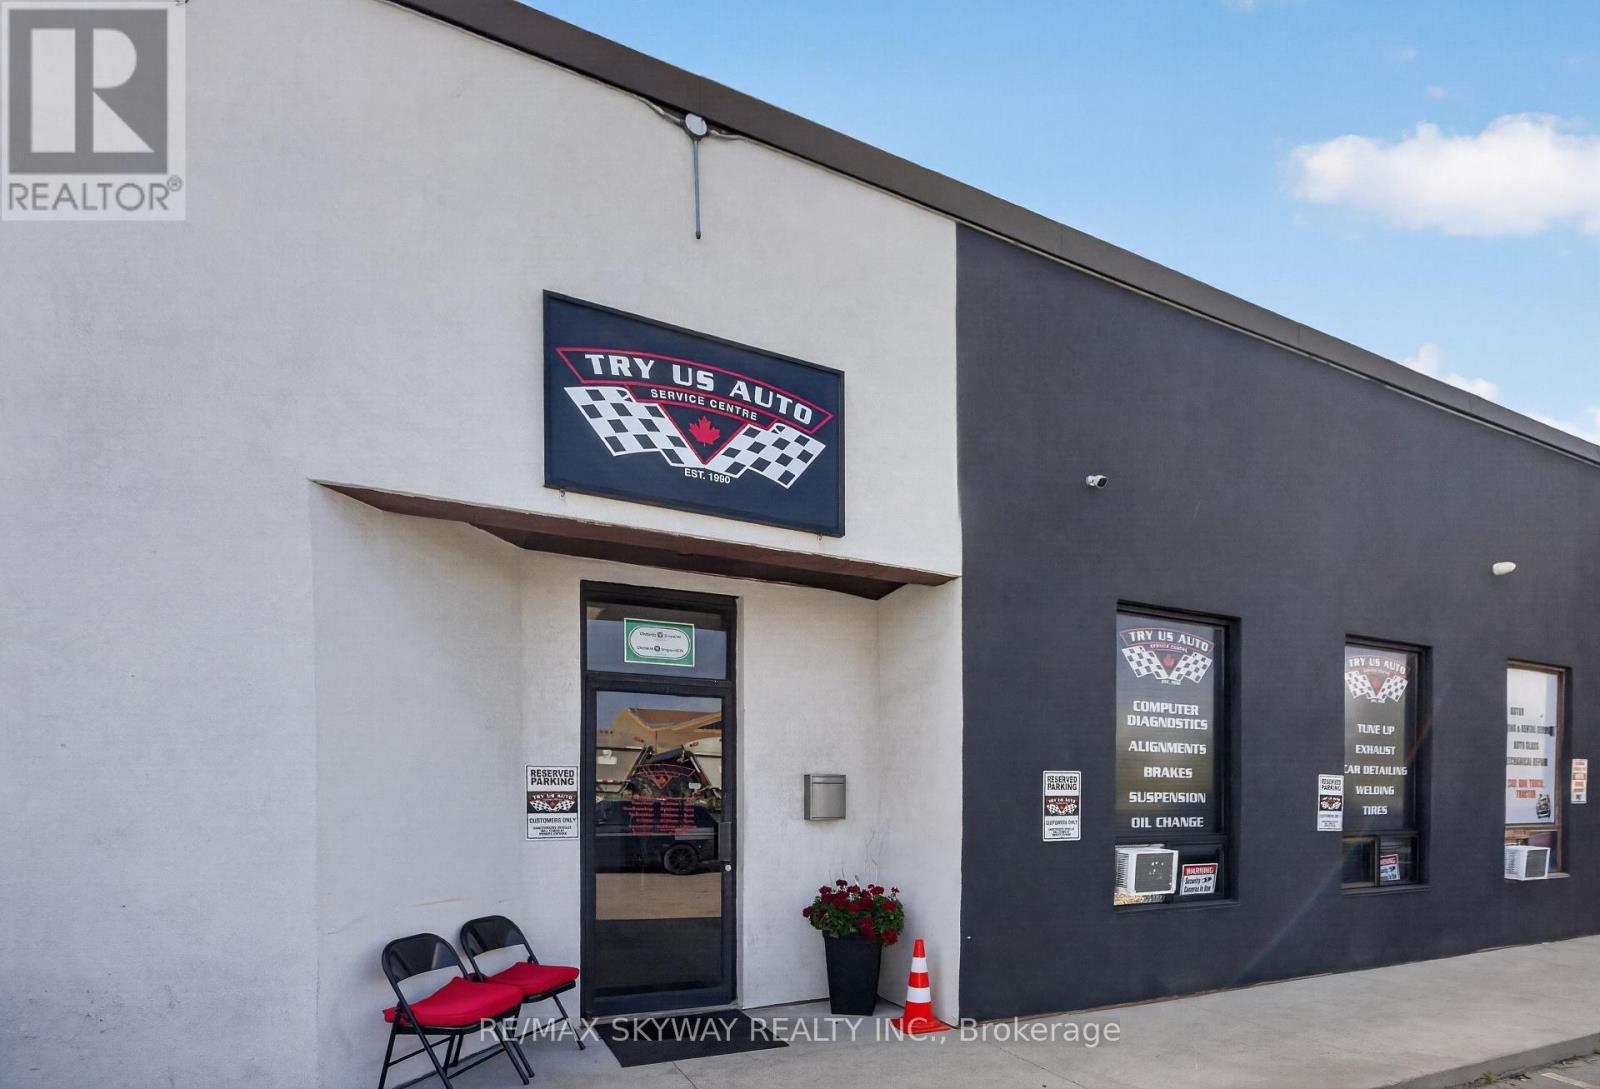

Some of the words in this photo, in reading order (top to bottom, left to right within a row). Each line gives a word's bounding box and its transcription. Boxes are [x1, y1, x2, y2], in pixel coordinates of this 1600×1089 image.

[585, 354, 654, 379] TRY
[672, 363, 714, 392] US
[729, 380, 813, 425] AUTO
[650, 388, 705, 406] SERVICE
[710, 400, 757, 421] CENTRE
[684, 468, 705, 480] EST.
[708, 472, 731, 484] 1990
[1128, 630, 1153, 642] TRY
[1158, 631, 1174, 642] US
[1178, 635, 1209, 652] AUTO
[1349, 657, 1366, 668] TRY
[1369, 657, 1380, 667] US
[1383, 660, 1406, 675] AUTO
[1133, 700, 1199, 716] COMPUTER
[1127, 714, 1208, 730] DIAGNOSTICS
[1357, 724, 1380, 734] TUNE
[1382, 725, 1395, 735] UP
[1128, 740, 1207, 755] ALIGNMENTS
[1355, 744, 1396, 755] EXHAUST
[530, 769, 575, 778] RESERVED
[1144, 767, 1193, 778] BRAKES
[1363, 765, 1408, 776] DETAILING
[530, 777, 575, 786] PARKING
[1047, 776, 1077, 784] RESERVED
[1047, 783, 1077, 791] PARKING
[1355, 785, 1395, 795] WELDING
[1129, 792, 1206, 804] SUSPENSION
[1362, 805, 1388, 815] TIRES
[1131, 817, 1152, 829] OIL
[1156, 817, 1204, 828] CHANGE
[1186, 866, 1214, 875] WARNING
